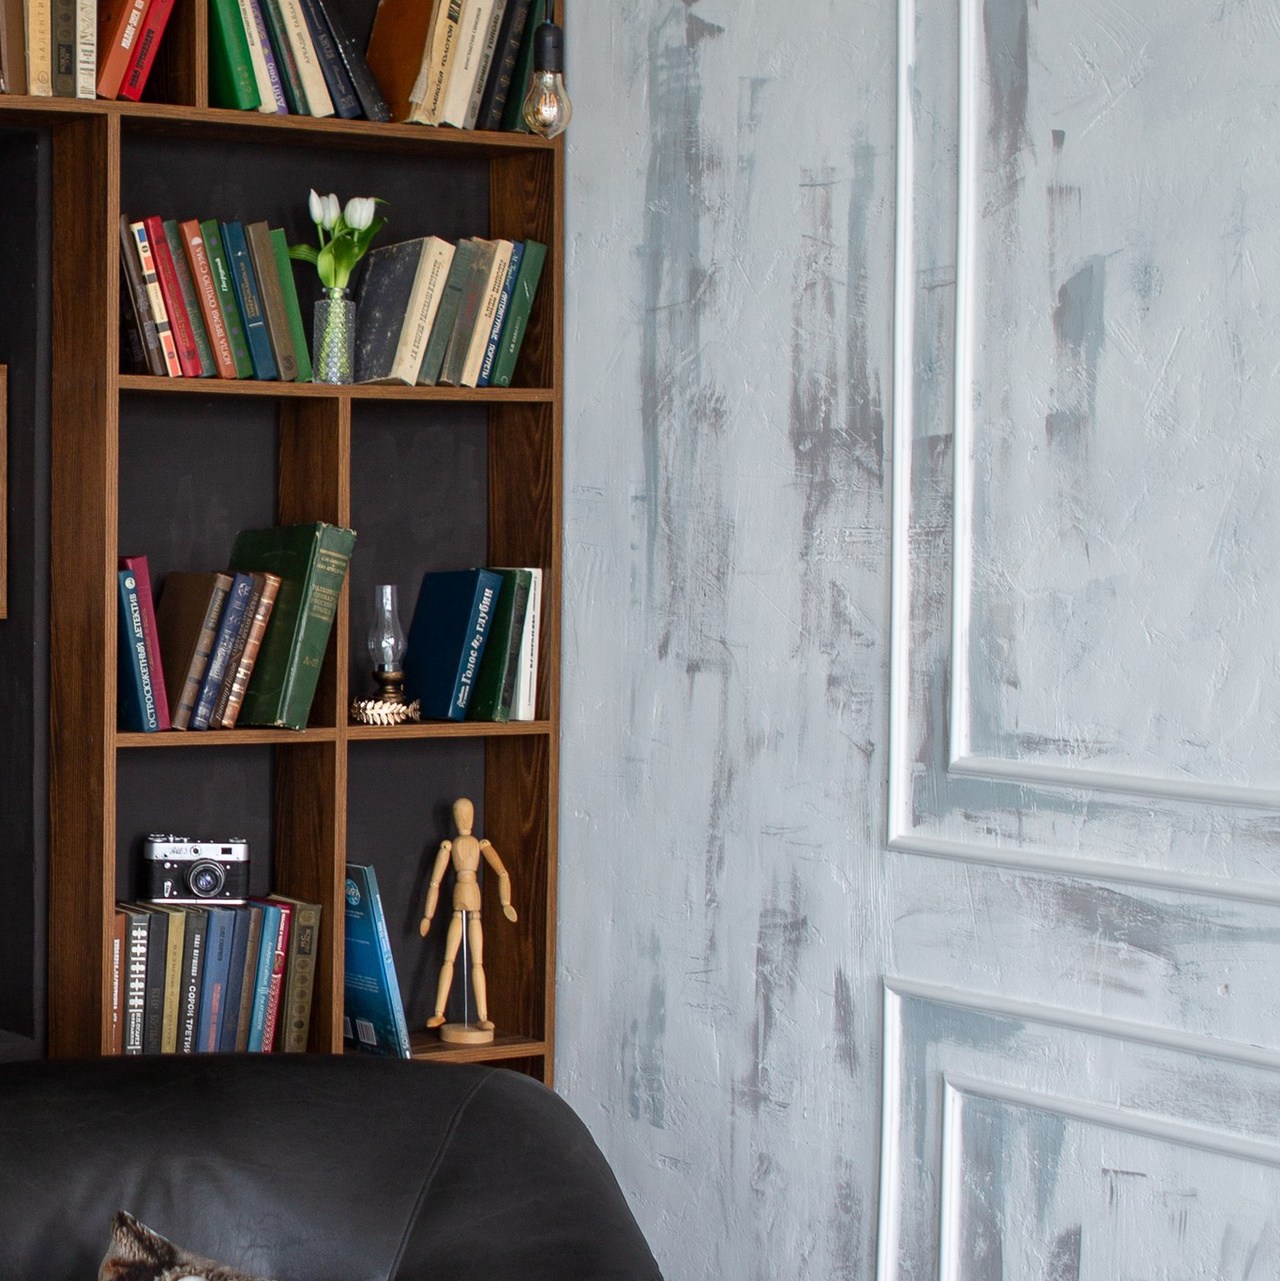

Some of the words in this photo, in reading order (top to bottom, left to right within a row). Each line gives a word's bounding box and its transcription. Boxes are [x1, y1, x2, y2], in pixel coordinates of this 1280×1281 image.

[241, 9, 255, 46] КОНСТАНТИН
[286, 0, 300, 28] ГАЙДАР
[294, 29, 311, 65] АРКАДИЙ
[462, 34, 476, 70] КОНСТАНТИН
[471, 6, 483, 33] СИМОНОВ
[485, 13, 501, 51] ТОПОЛЬ
[429, 70, 445, 115] АЛЕКСЕЙ
[438, 23, 455, 67] ТОЛСТОЙ
[195, 248, 206, 267] УМА
[202, 276, 217, 307] СОШЛО
[211, 310, 225, 336] ВРЕМЯ
[488, 291, 510, 339] ЛИТЕРАТУРНЫЕ
[218, 338, 232, 364] КОГДА
[479, 342, 497, 378] ПОРТРЕТЫ
[128, 593, 143, 638] ДЕТЕКТИВ
[472, 587, 496, 632] глубин
[470, 633, 482, 649] из
[460, 649, 478, 684] Голос
[135, 642, 158, 727] ОСТРОСЮЖЕТНЫЙ
[212, 687, 230, 721] Виктор
[151, 987, 159, 1008] КИР
[186, 985, 196, 1014] СОРОК
